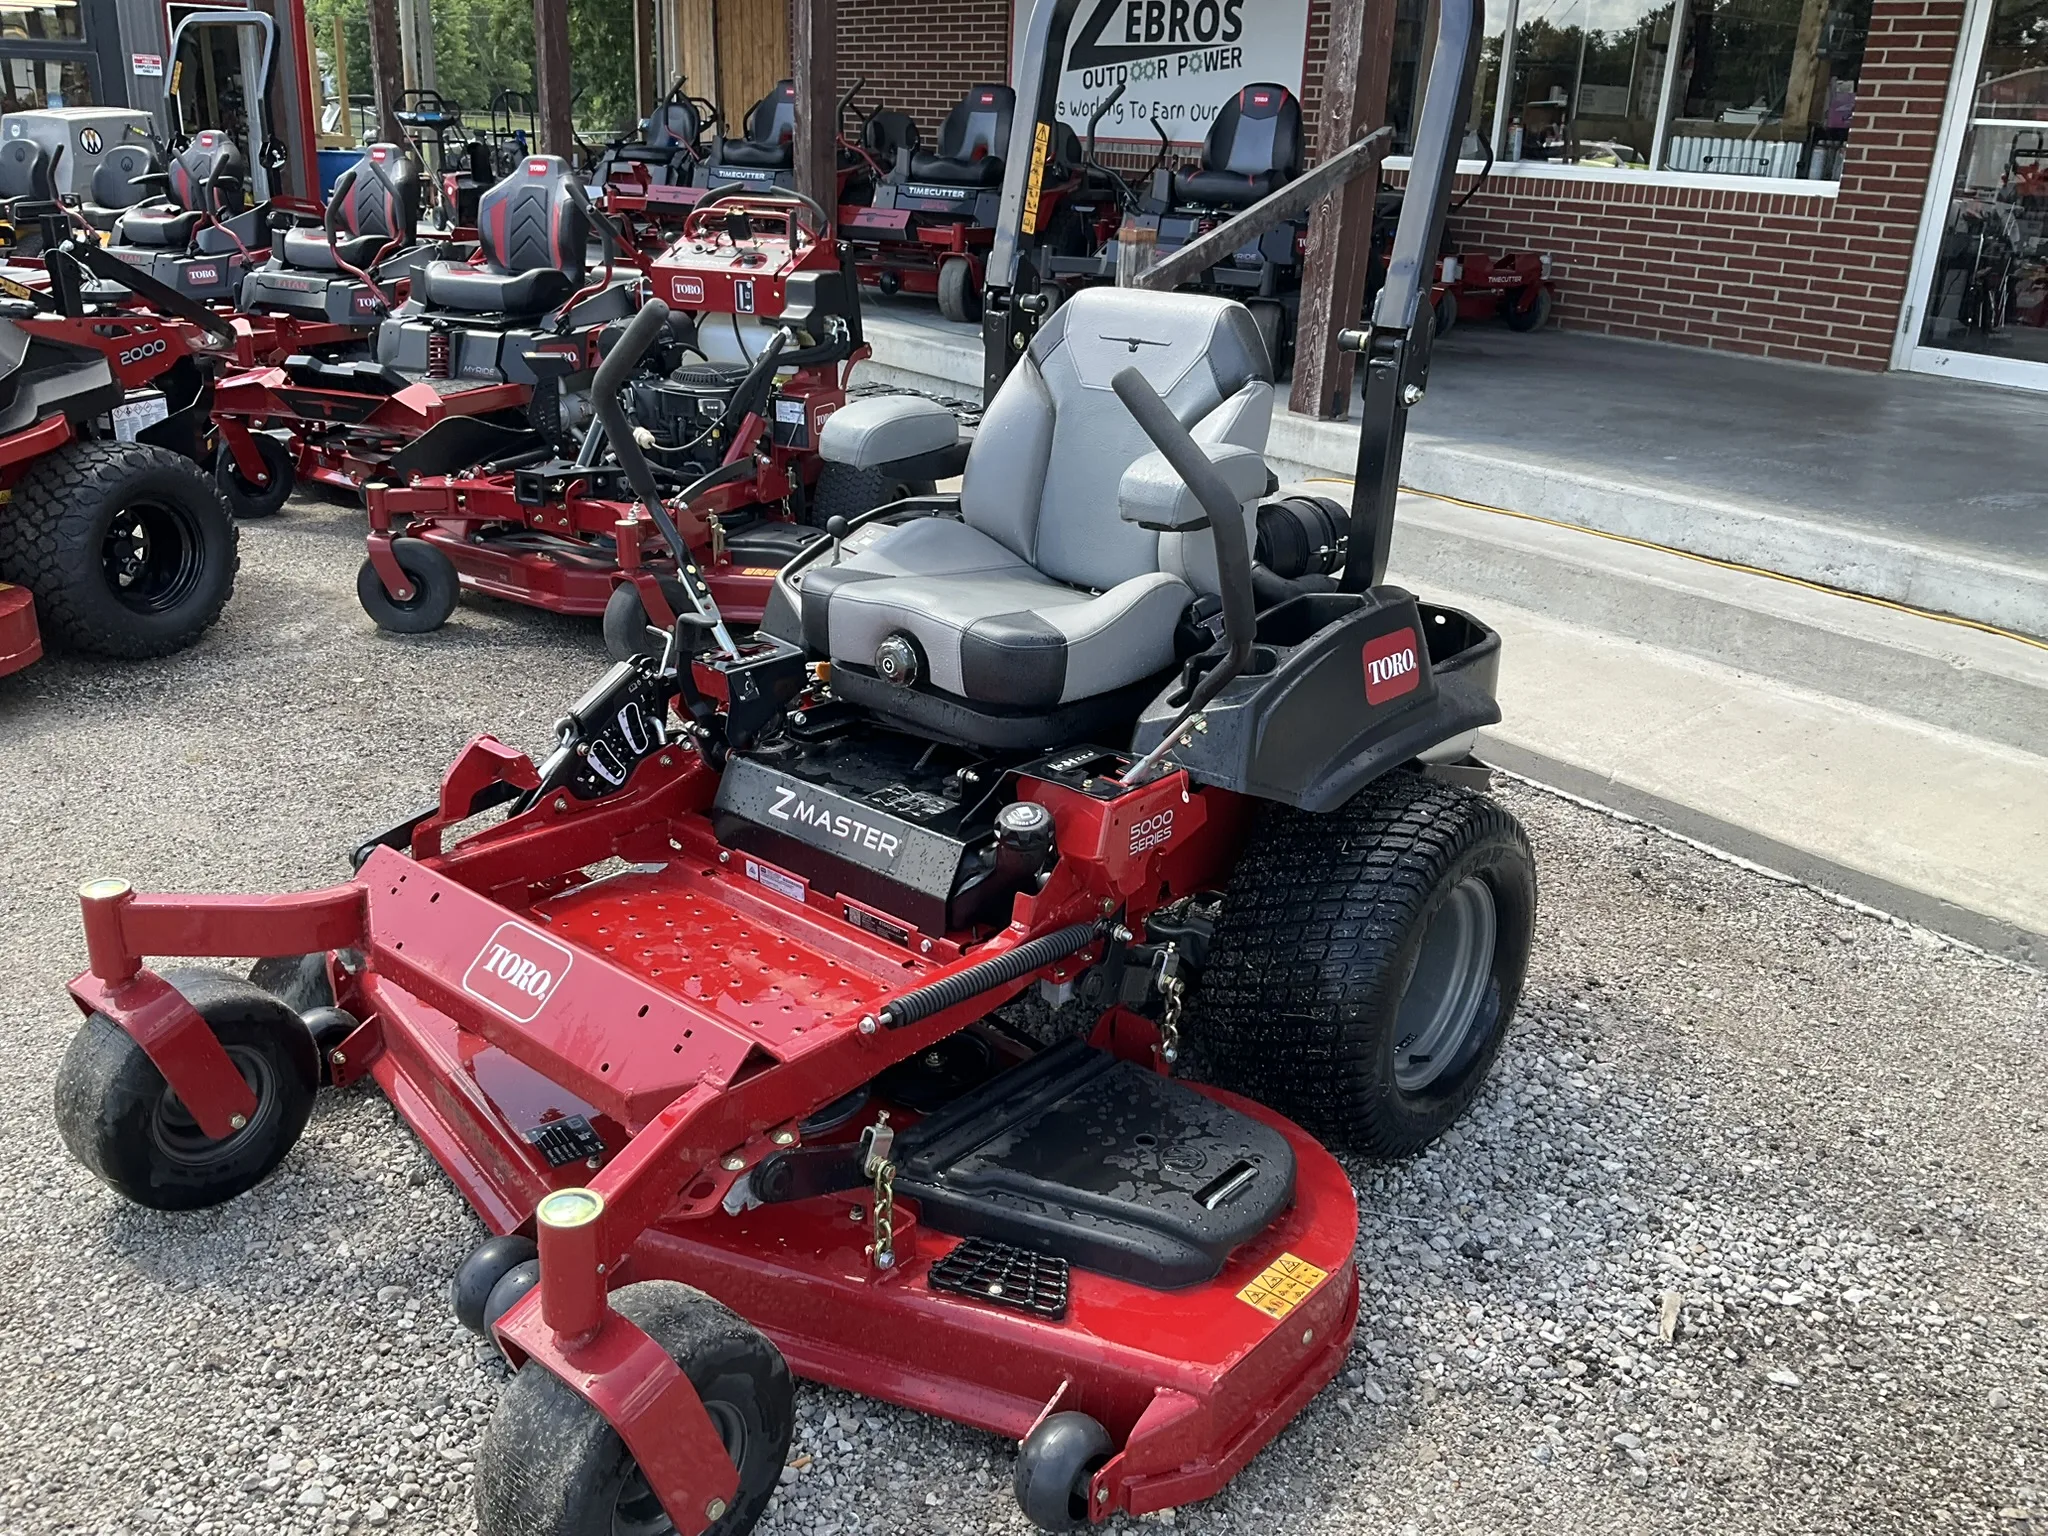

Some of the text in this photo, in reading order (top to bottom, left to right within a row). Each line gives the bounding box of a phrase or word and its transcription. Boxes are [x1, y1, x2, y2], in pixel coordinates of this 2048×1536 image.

[1067, 0, 1244, 72] ZEBROS
[1082, 46, 1243, 90] OUTDOOR POWER
[1070, 96, 1124, 125] Worng
[1129, 100, 1147, 119] To
[1152, 101, 1185, 120] Earn
[718, 170, 766, 180] TIMECUTTER
[908, 186, 965, 198] TIMECUTTER
[189, 269, 217, 280] TORO
[675, 283, 702, 295] TORO
[1487, 275, 1523, 283] TIMECUTTER
[119, 339, 167, 366] 2000
[1367, 648, 1415, 685] TORO
[768, 785, 899, 858] Z MASTER
[1130, 809, 1174, 841] 5000
[1129, 825, 1172, 856] SERIES
[483, 943, 551, 999] TORO
